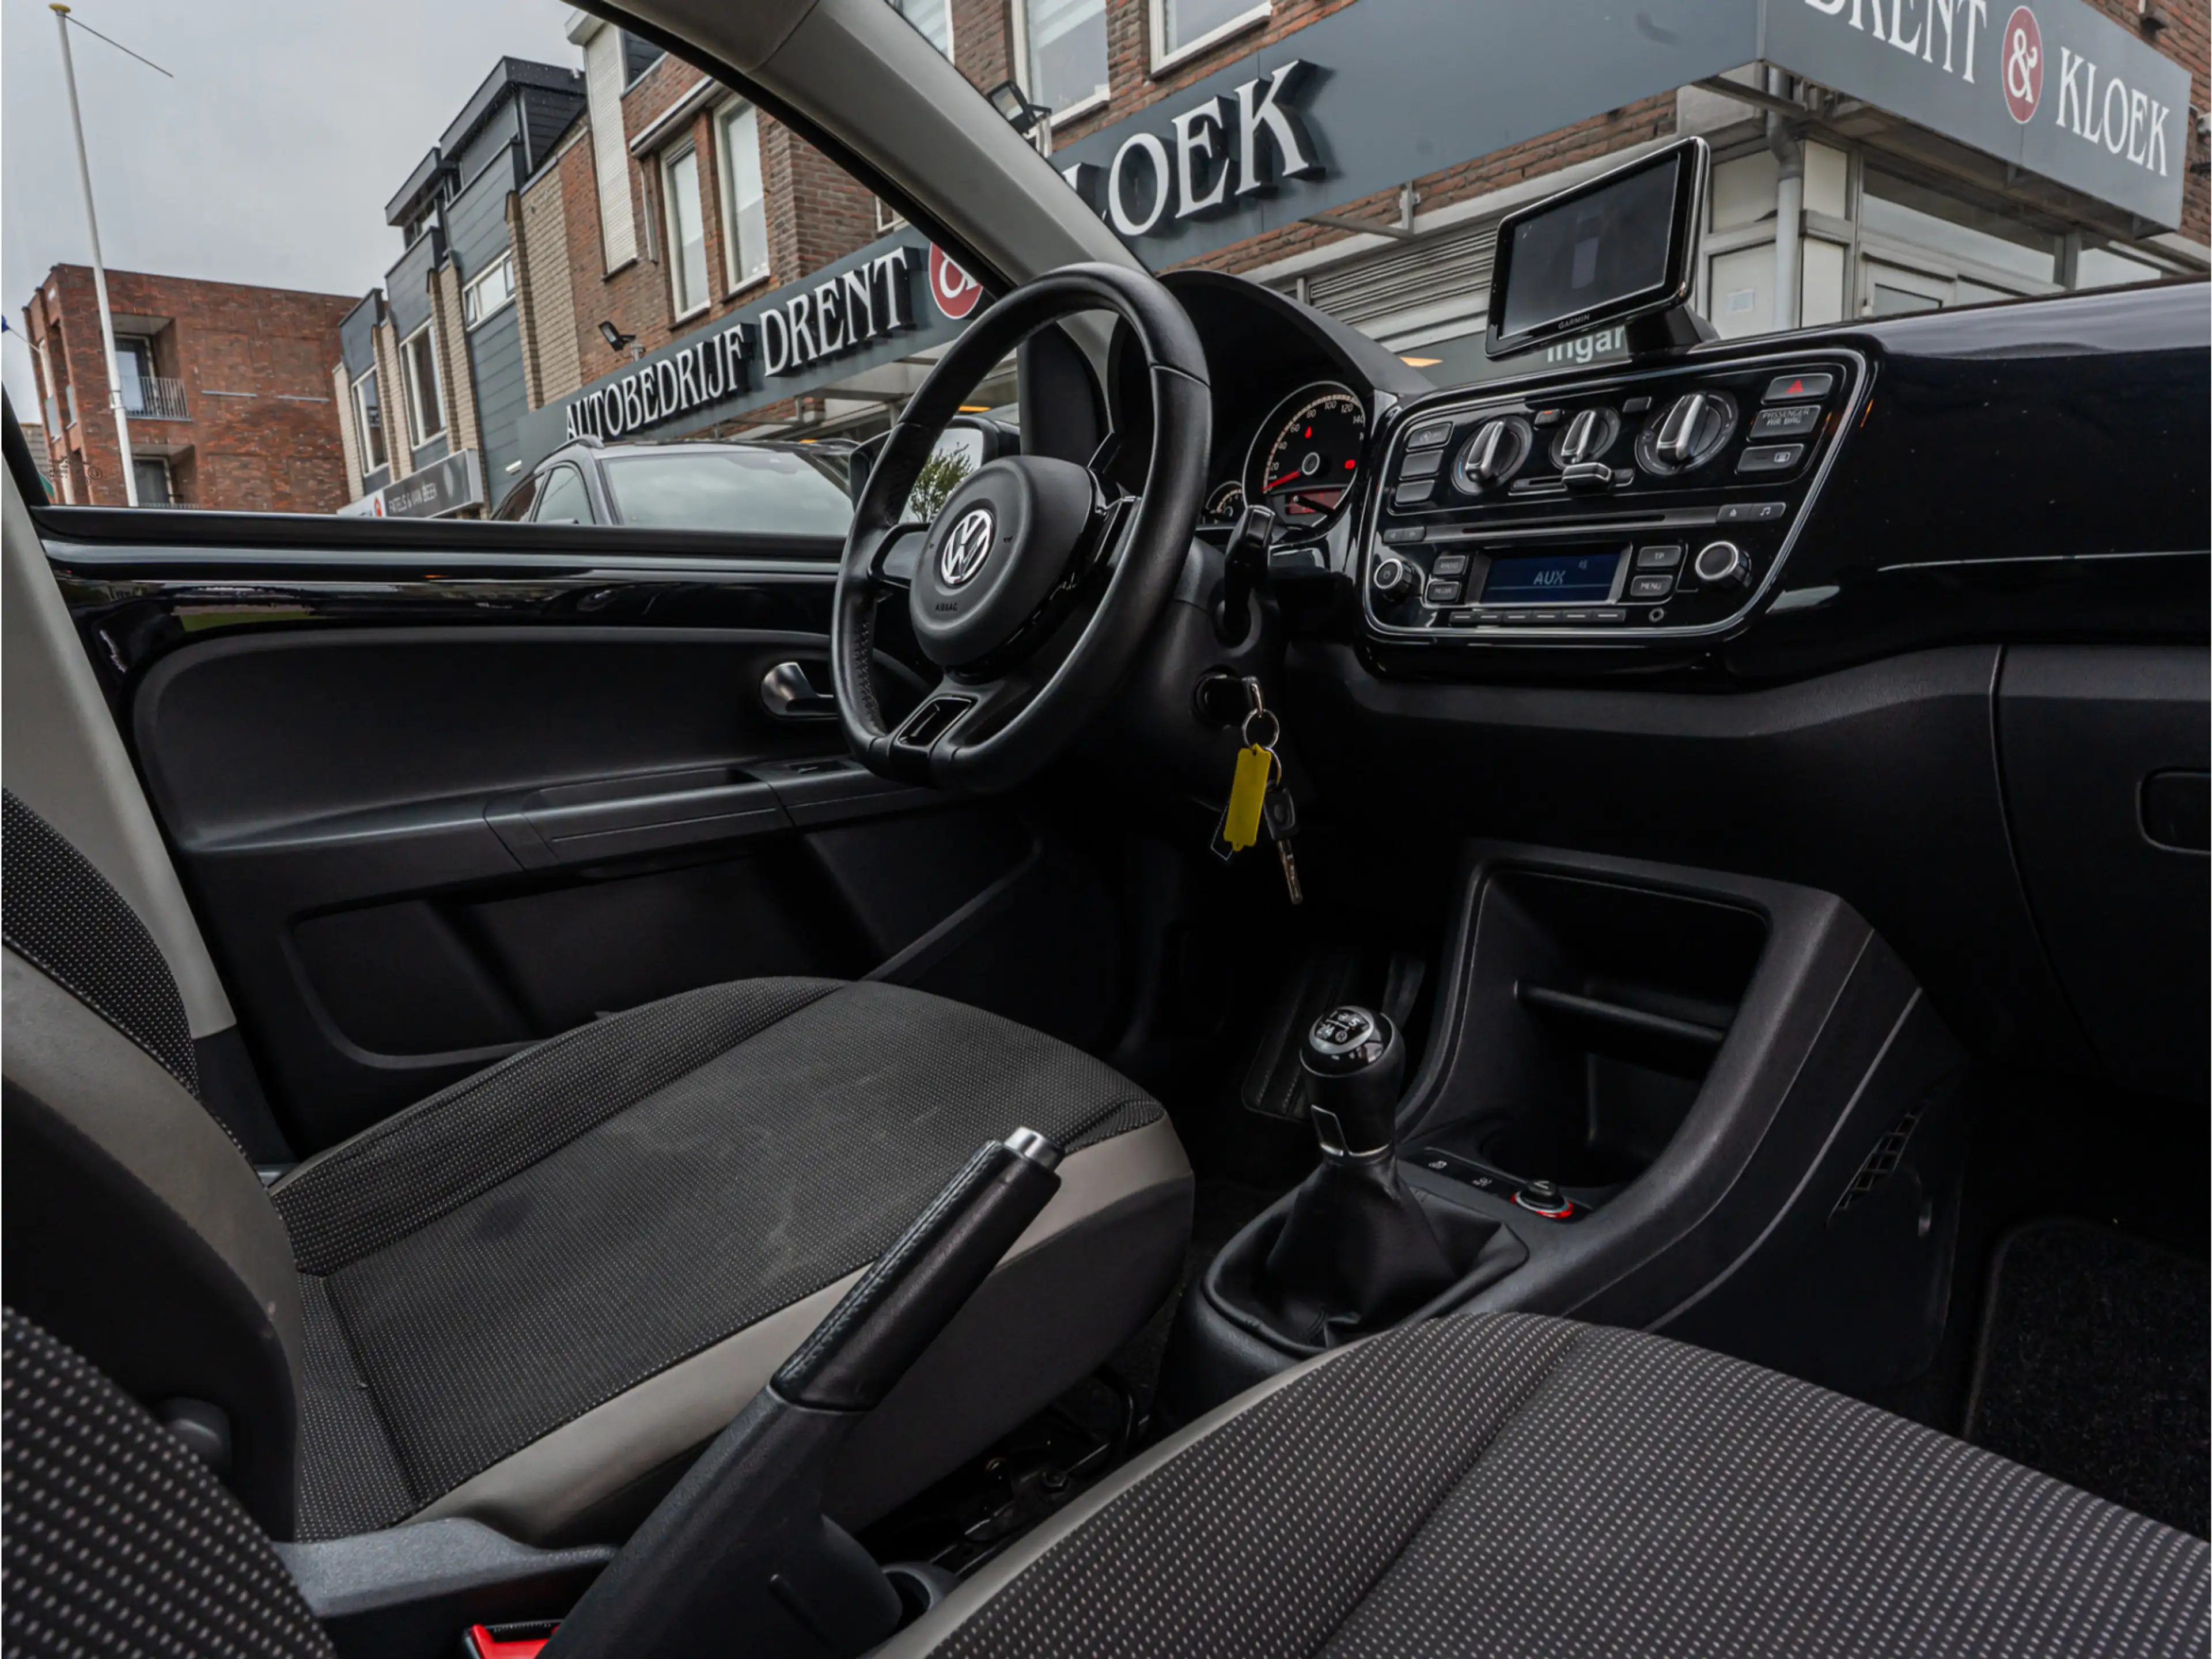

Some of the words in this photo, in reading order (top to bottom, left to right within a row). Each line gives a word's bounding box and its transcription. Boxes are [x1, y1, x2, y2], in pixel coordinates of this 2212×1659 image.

[1805, 0, 1987, 84] ENT
[2008, 29, 2037, 103] &
[2056, 47, 2171, 176] KLOEK
[1558, 314, 1590, 329] GARMIN
[567, 324, 744, 441] AUTOBEDRIJF
[760, 247, 907, 377] DRENT
[1325, 401, 1337, 410] 100
[1341, 404, 1353, 413] 120
[1306, 410, 1316, 418] 80
[1290, 423, 1300, 433] 60
[1270, 462, 1279, 470] 20
[1533, 571, 1566, 585] AUX
[1640, 582, 1661, 590] MENU
[1348, 1017, 1361, 1027] 5
